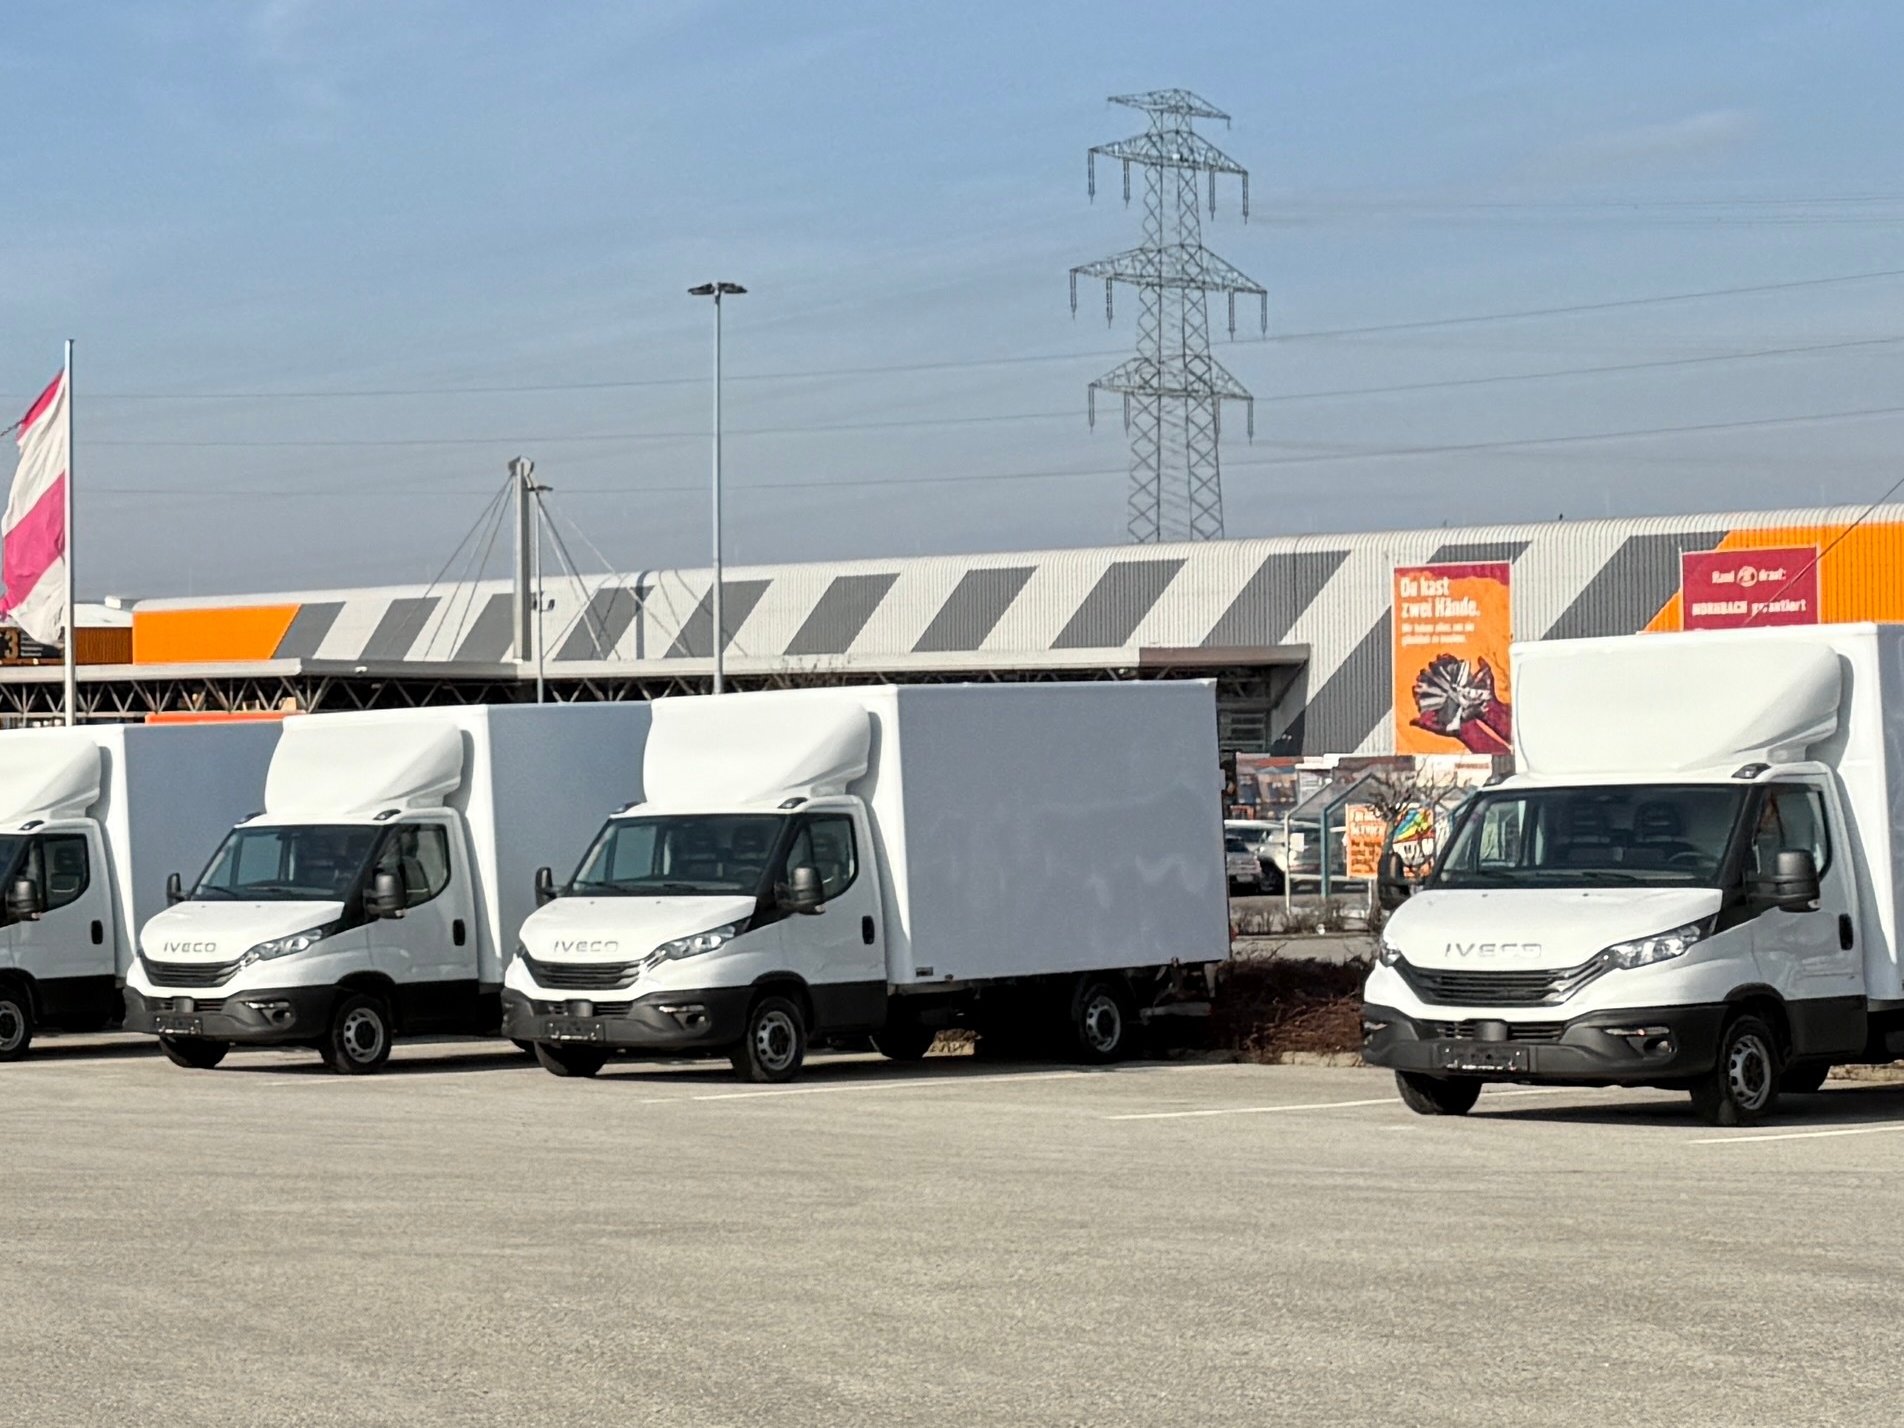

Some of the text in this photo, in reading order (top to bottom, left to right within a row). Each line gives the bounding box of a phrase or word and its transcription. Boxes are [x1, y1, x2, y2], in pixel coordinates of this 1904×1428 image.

[1401, 598, 1432, 618] zwei
[163, 942, 217, 953] IVECO
[554, 940, 619, 952] IVECO
[1445, 943, 1542, 957] IVECO
